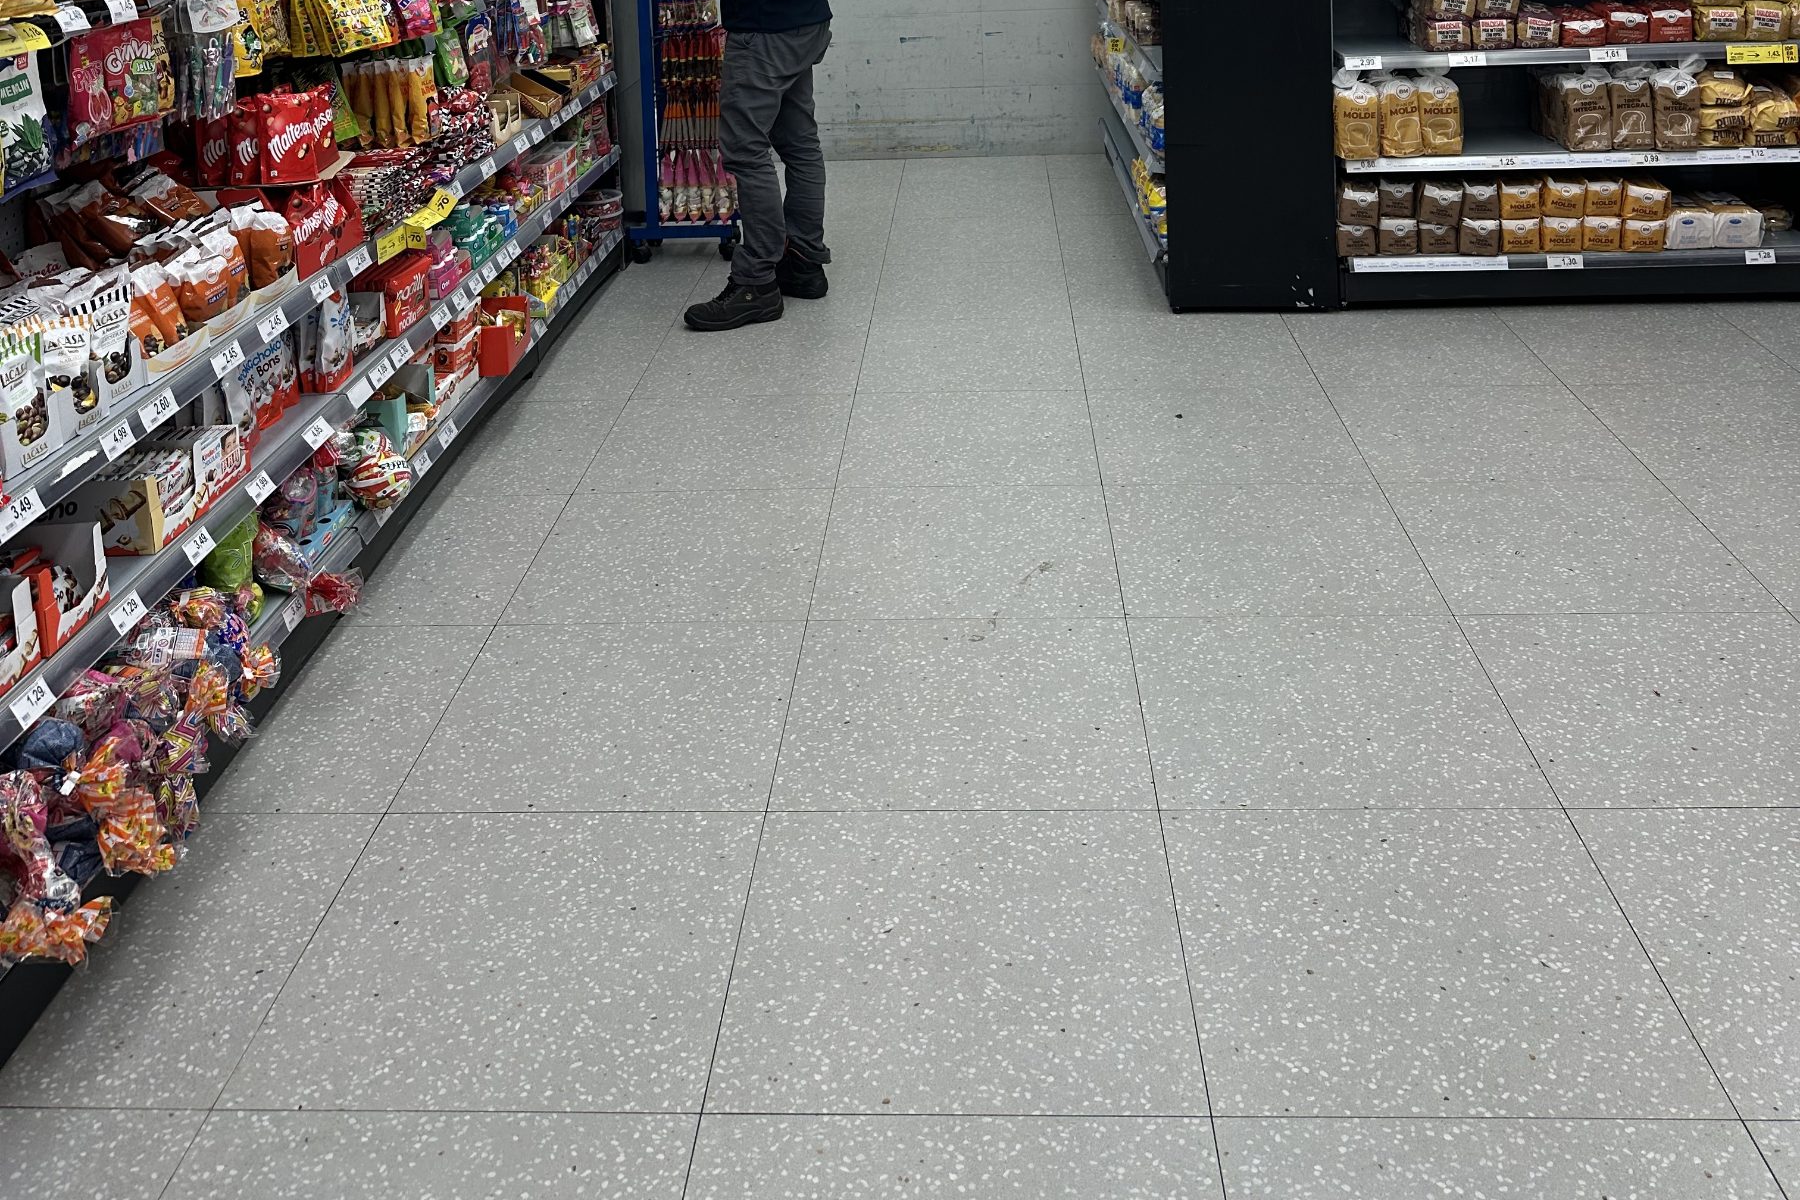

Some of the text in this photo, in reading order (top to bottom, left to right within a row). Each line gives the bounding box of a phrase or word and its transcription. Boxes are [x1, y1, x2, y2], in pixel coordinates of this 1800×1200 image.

[1344, 111, 1377, 119] MOLDE
[1390, 106, 1418, 116] MOLD
[1424, 106, 1458, 115] MOLDE
[1632, 208, 1658, 216] MOLDE
[408, 235, 422, 243] -70
[1632, 239, 1658, 247] MOLDE
[256, 353, 280, 378] Bons
[154, 397, 170, 415] 2,60
[113, 427, 127, 443] 4,99
[11, 496, 33, 519] 3,49
[194, 532, 207, 549] 3,49
[122, 598, 138, 617] 1,29
[26, 685, 46, 707] 1,29
